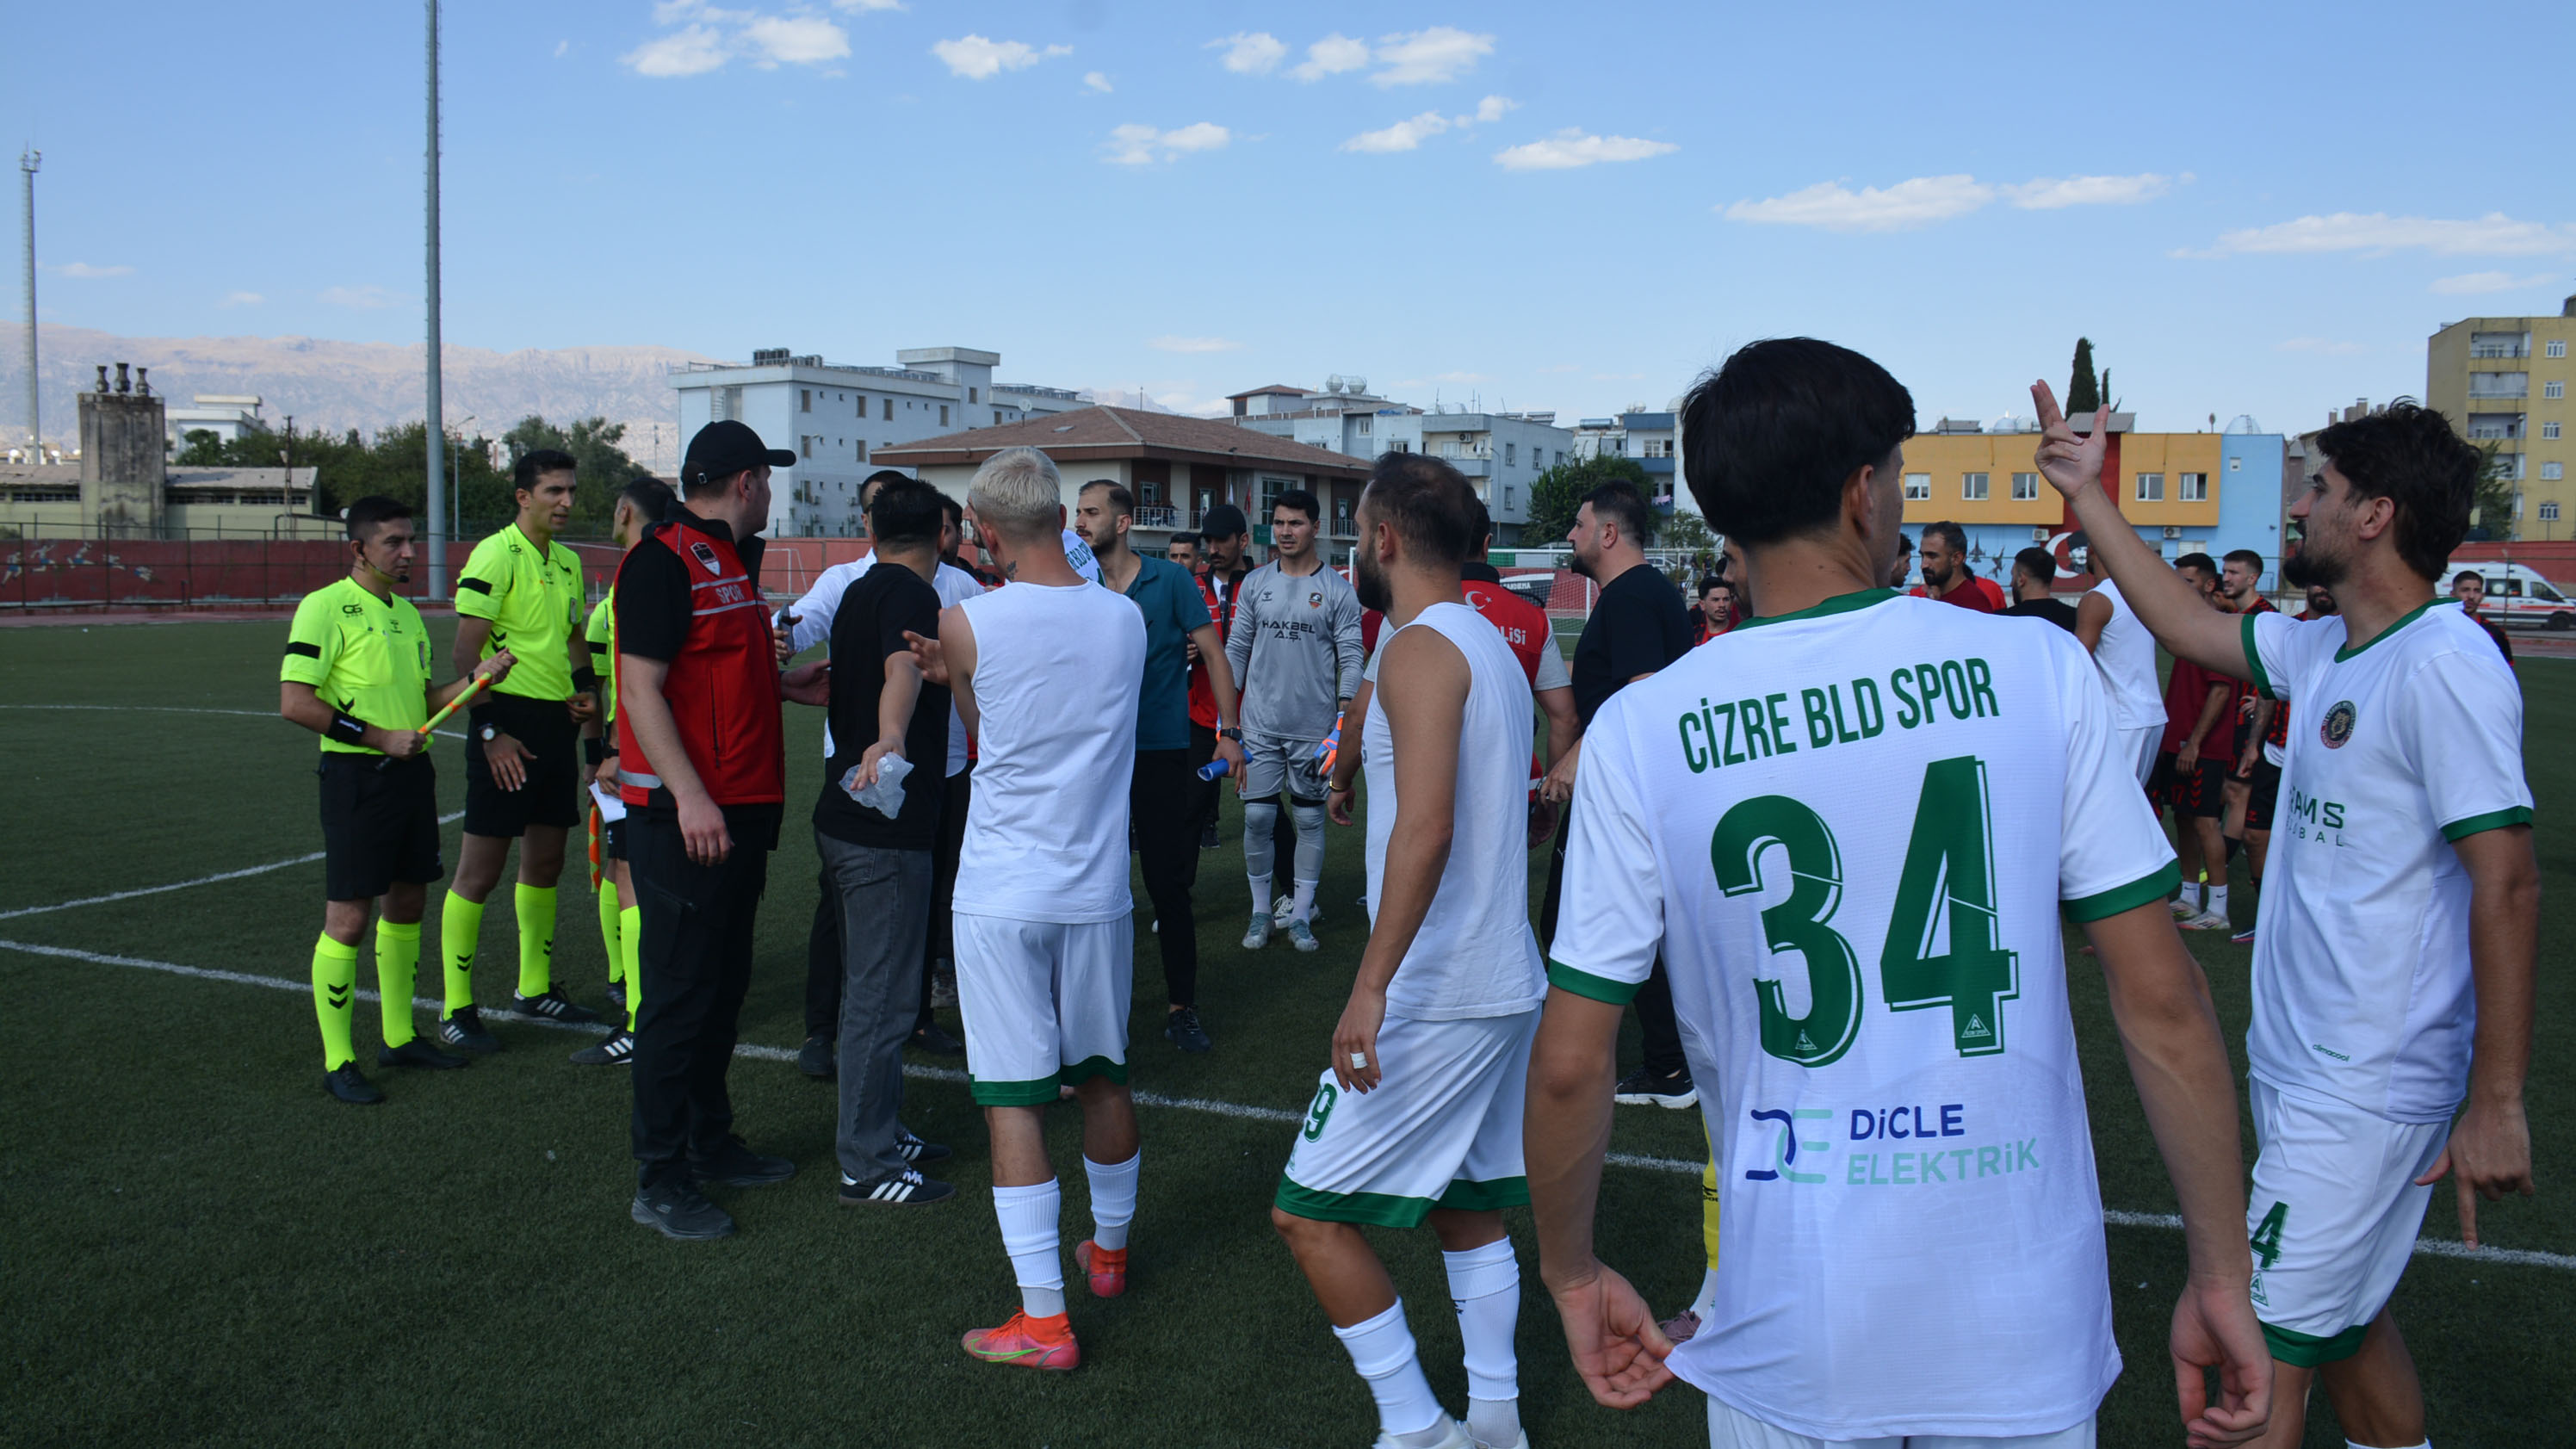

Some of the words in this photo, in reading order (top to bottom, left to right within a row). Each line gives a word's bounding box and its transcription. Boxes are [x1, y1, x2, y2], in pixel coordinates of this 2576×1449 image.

[715, 585, 745, 604] SPOR
[1262, 620, 1316, 634] HAKBEL
[1679, 697, 1798, 774] CİZRE
[1801, 677, 1886, 750] BLD
[1891, 657, 2000, 730] SPOR
[1710, 754, 2020, 1068] 34
